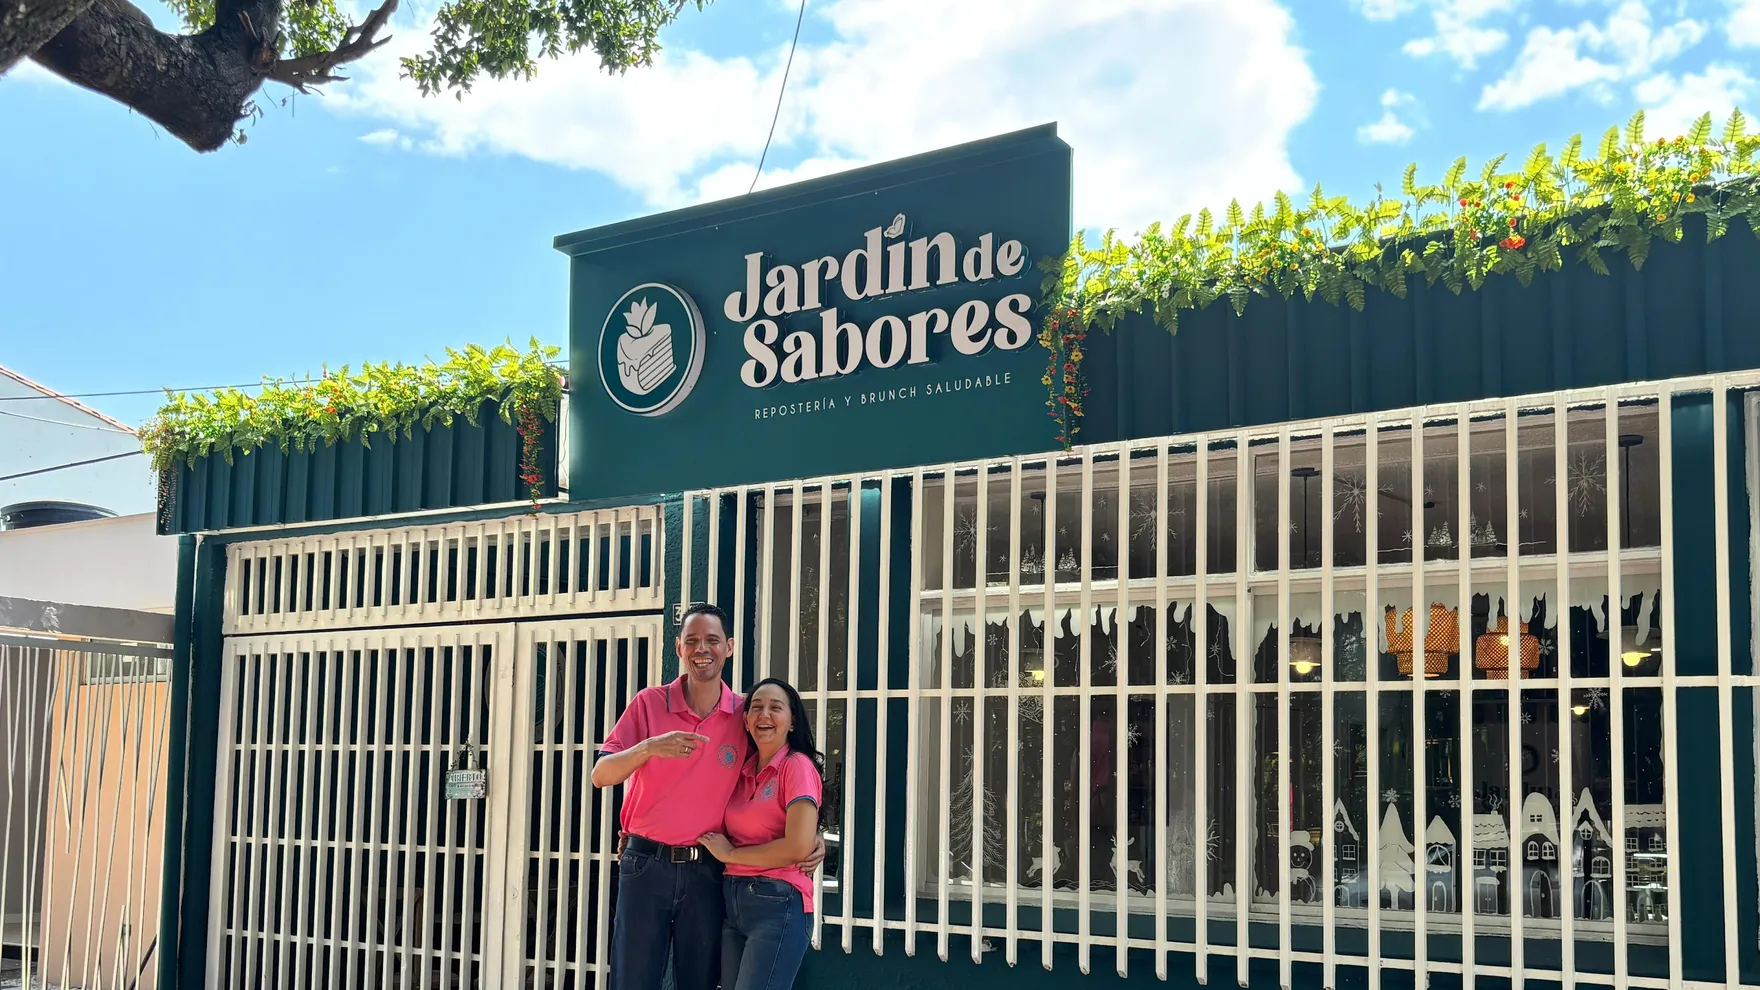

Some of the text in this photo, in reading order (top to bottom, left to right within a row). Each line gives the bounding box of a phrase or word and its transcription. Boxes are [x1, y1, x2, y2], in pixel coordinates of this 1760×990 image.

[963, 232, 1025, 282] de
[740, 293, 1032, 388] Sabores
[754, 372, 1012, 420] REPOSTERÍA Y BRUNCH SALUDABLE
